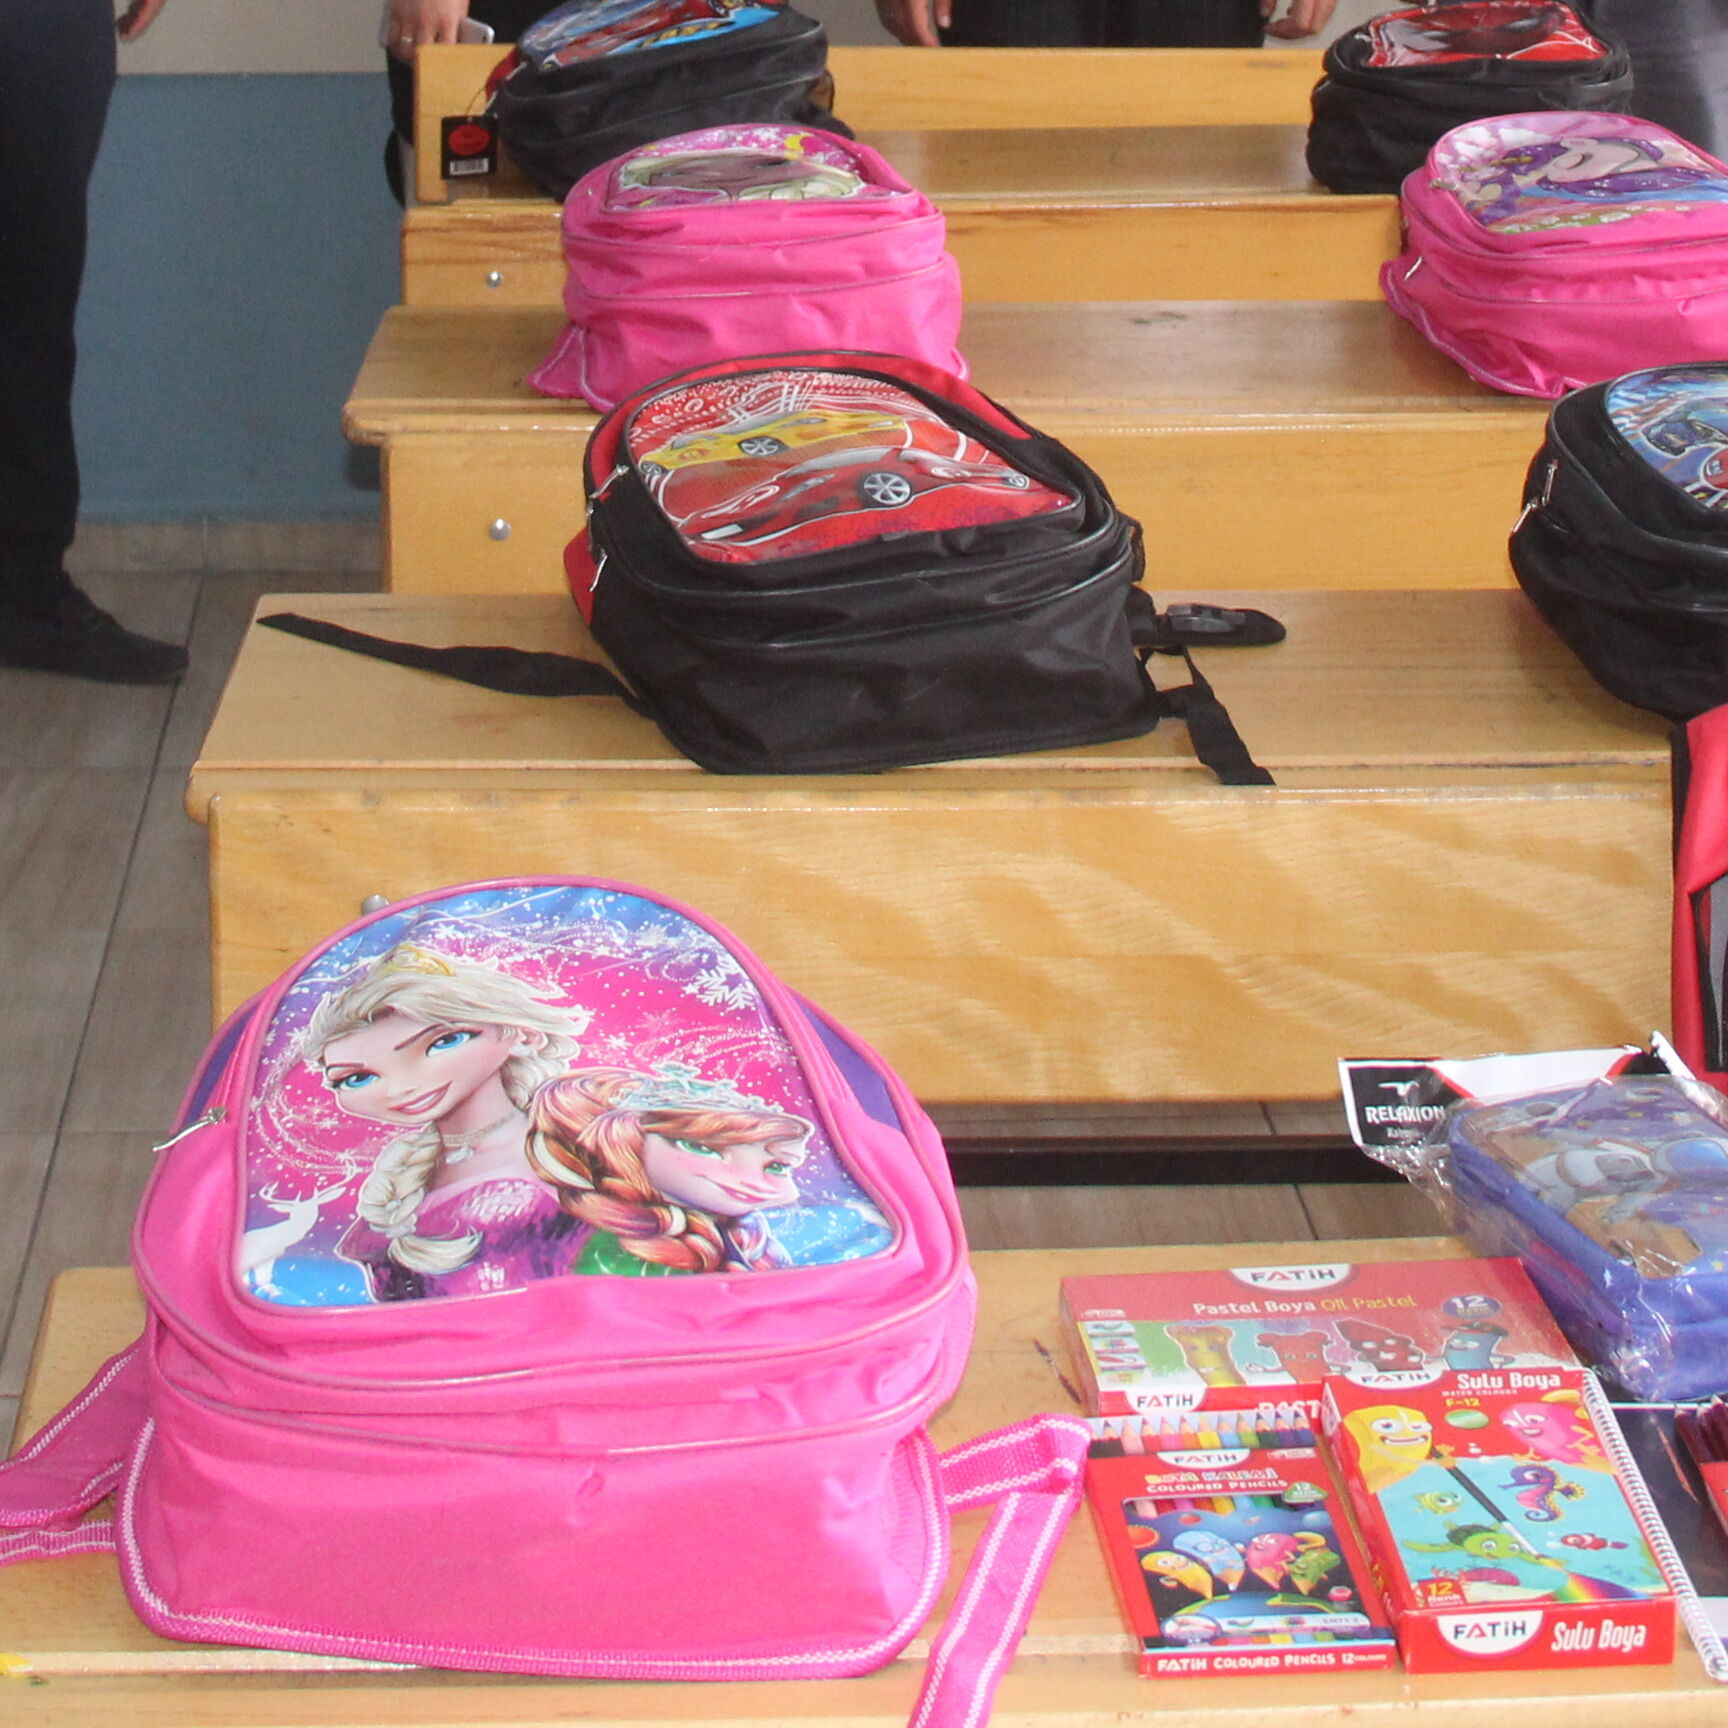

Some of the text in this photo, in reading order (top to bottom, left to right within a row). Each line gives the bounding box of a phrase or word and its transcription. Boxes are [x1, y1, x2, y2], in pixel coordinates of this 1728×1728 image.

[1364, 1105, 1446, 1124] RELAXION
[1193, 1302, 1261, 1316] Pastel
[1265, 1300, 1316, 1314] Boya
[1354, 1295, 1418, 1310] Pastel
[1450, 1295, 1488, 1309] 12
[1456, 1372, 1561, 1389] Sulu Boya
[1445, 1398, 1481, 1407] F-12
[1146, 1479, 1288, 1494] COLOURED PENCILS
[1427, 1580, 1454, 1596] 12
[1551, 1619, 1648, 1653] Sulu Boya
[1213, 1654, 1281, 1670] COLOURED
[1285, 1652, 1336, 1667] PENCILS
